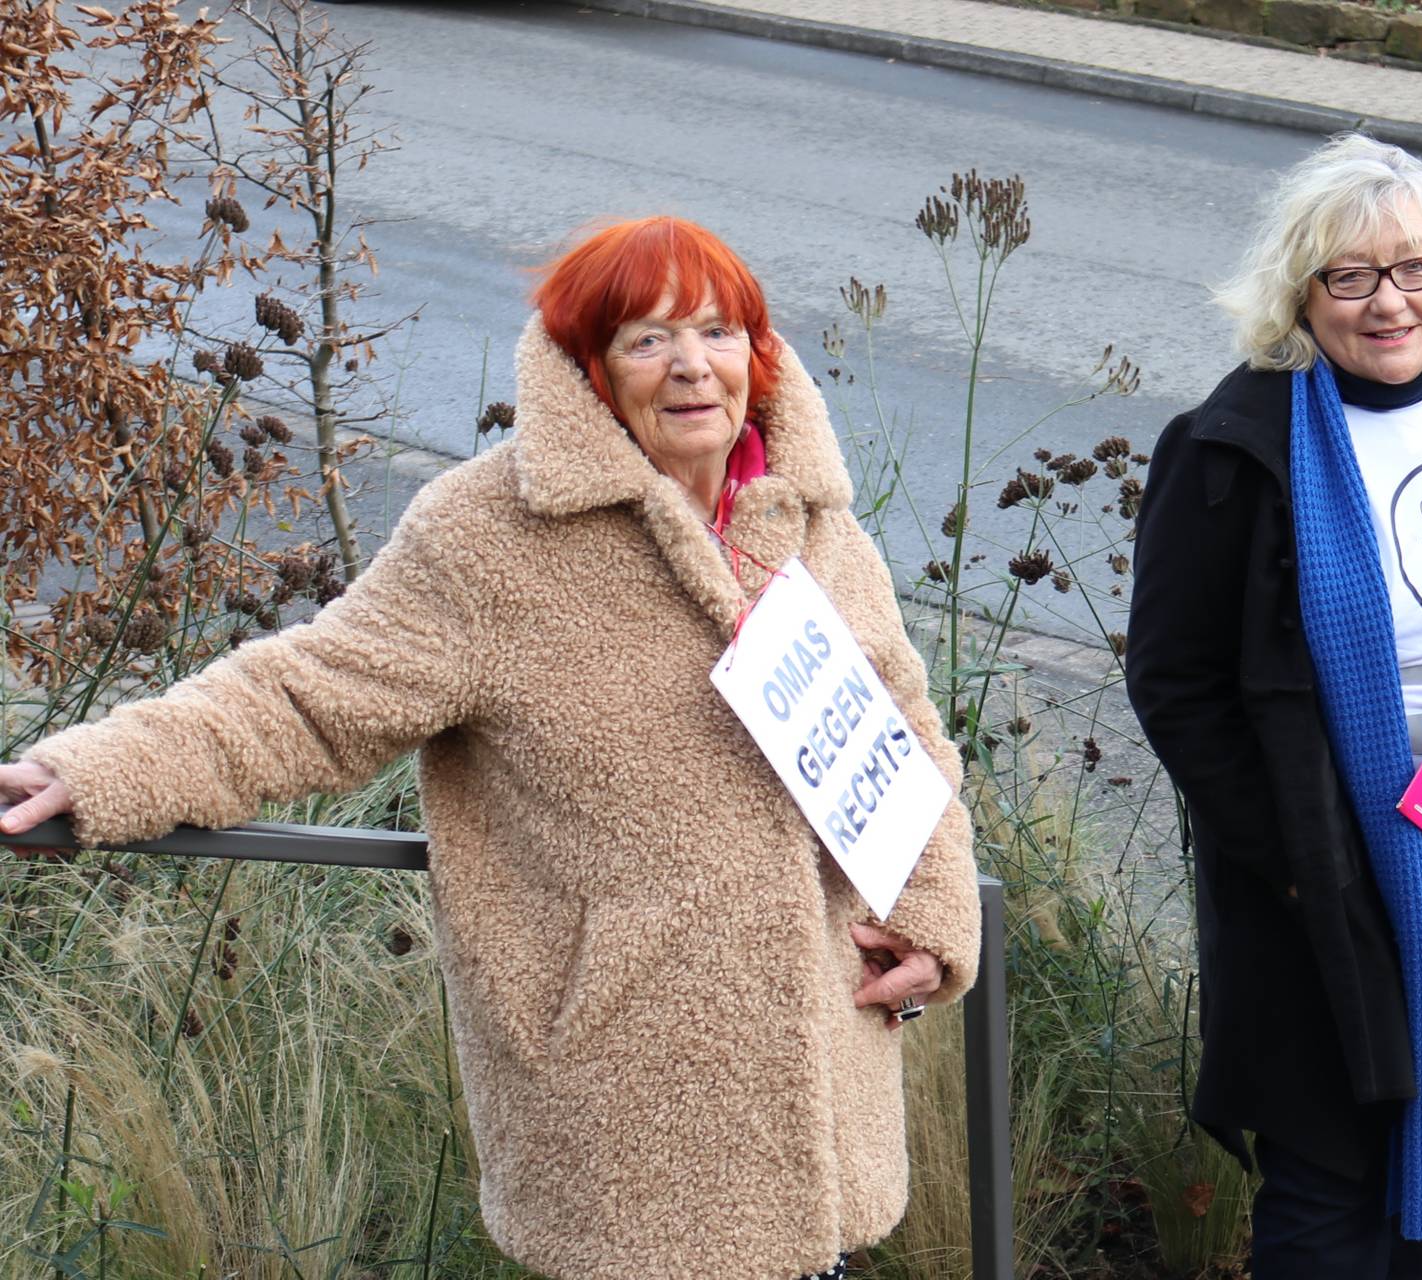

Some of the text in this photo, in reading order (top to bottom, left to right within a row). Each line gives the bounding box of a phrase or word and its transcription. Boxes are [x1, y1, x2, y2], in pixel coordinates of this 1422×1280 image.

[762, 619, 832, 722] OMAS
[797, 666, 874, 788] GEGEN
[824, 716, 912, 854] RECHTS
